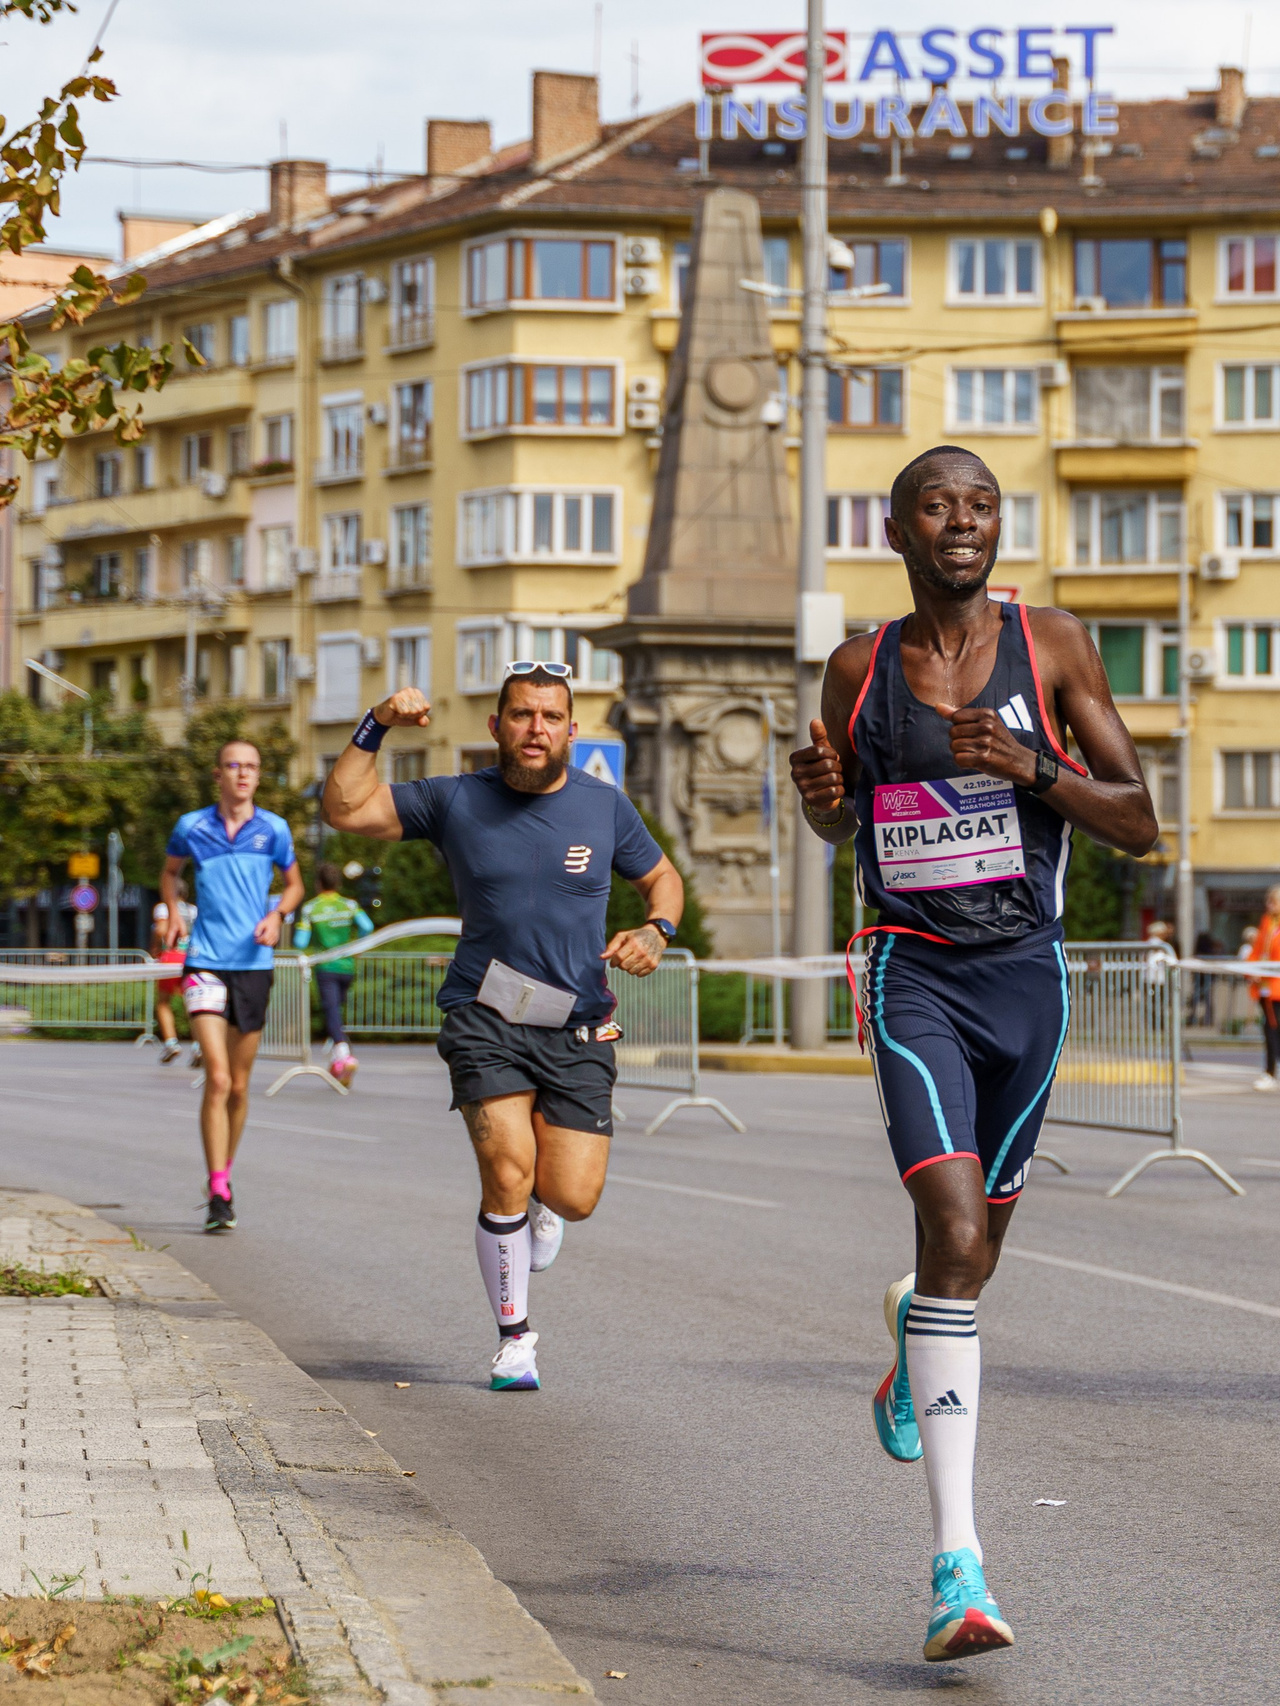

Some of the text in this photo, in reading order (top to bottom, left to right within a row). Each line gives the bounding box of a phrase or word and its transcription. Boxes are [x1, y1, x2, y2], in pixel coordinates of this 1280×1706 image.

[860, 27, 1114, 81] ASSET
[694, 90, 1119, 140] INSURANCE
[963, 780, 992, 790] 42.195
[960, 797, 976, 805] WIZZ
[991, 792, 1011, 800] SOFIA
[960, 801, 996, 811] MARATHON
[882, 813, 1008, 848] KIPLAGAT
[1004, 836, 1010, 844] 7
[895, 849, 920, 857] KENYA
[925, 1405, 968, 1416] adidas
